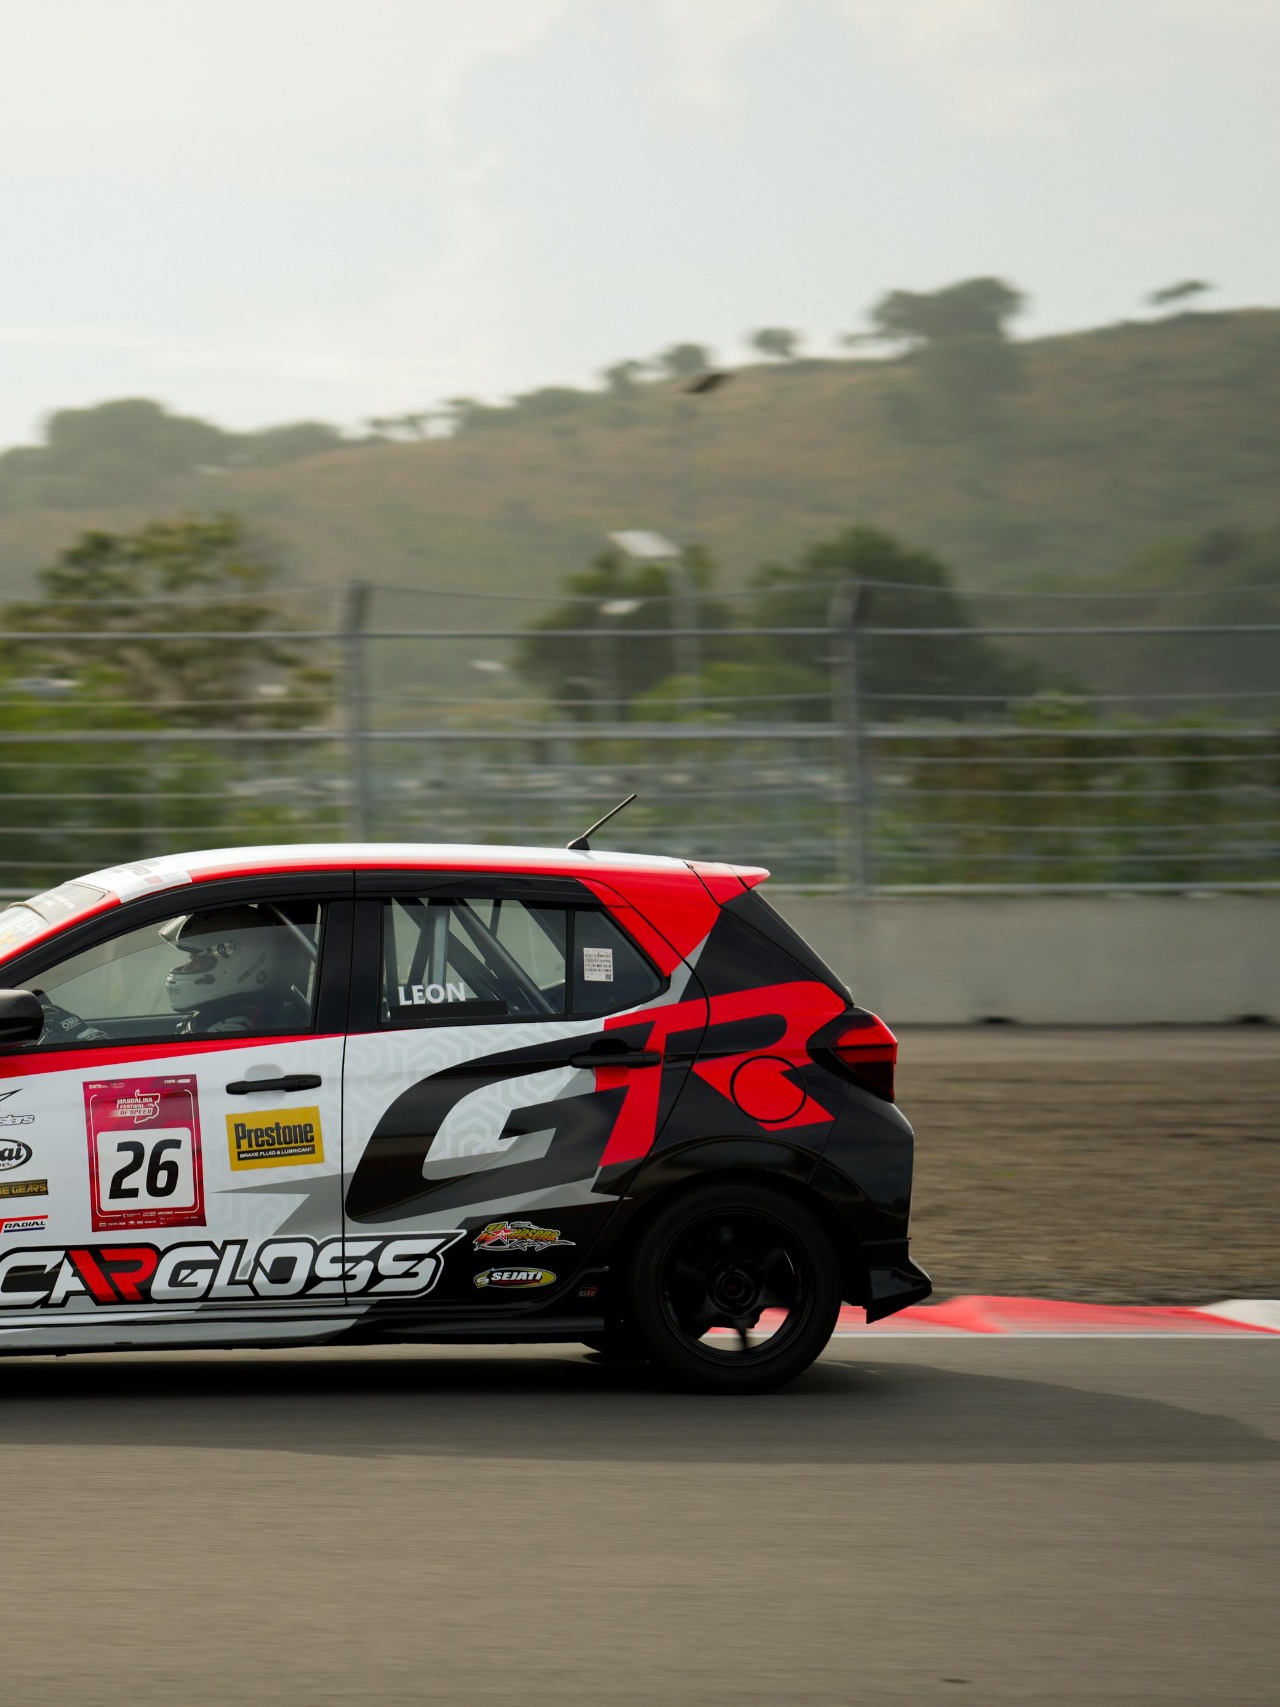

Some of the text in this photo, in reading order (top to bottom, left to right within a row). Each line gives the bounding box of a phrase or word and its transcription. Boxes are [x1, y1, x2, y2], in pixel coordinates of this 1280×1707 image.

[398, 982, 466, 1007] LEON
[234, 1121, 315, 1150] Prestone
[239, 1151, 259, 1159] BRAKE
[281, 1147, 313, 1155] LUBRICANT
[108, 1138, 182, 1200] 26
[11, 1183, 47, 1194] GEARS
[4, 1220, 47, 1229] RADIAL
[490, 1271, 543, 1281] SEJATI
